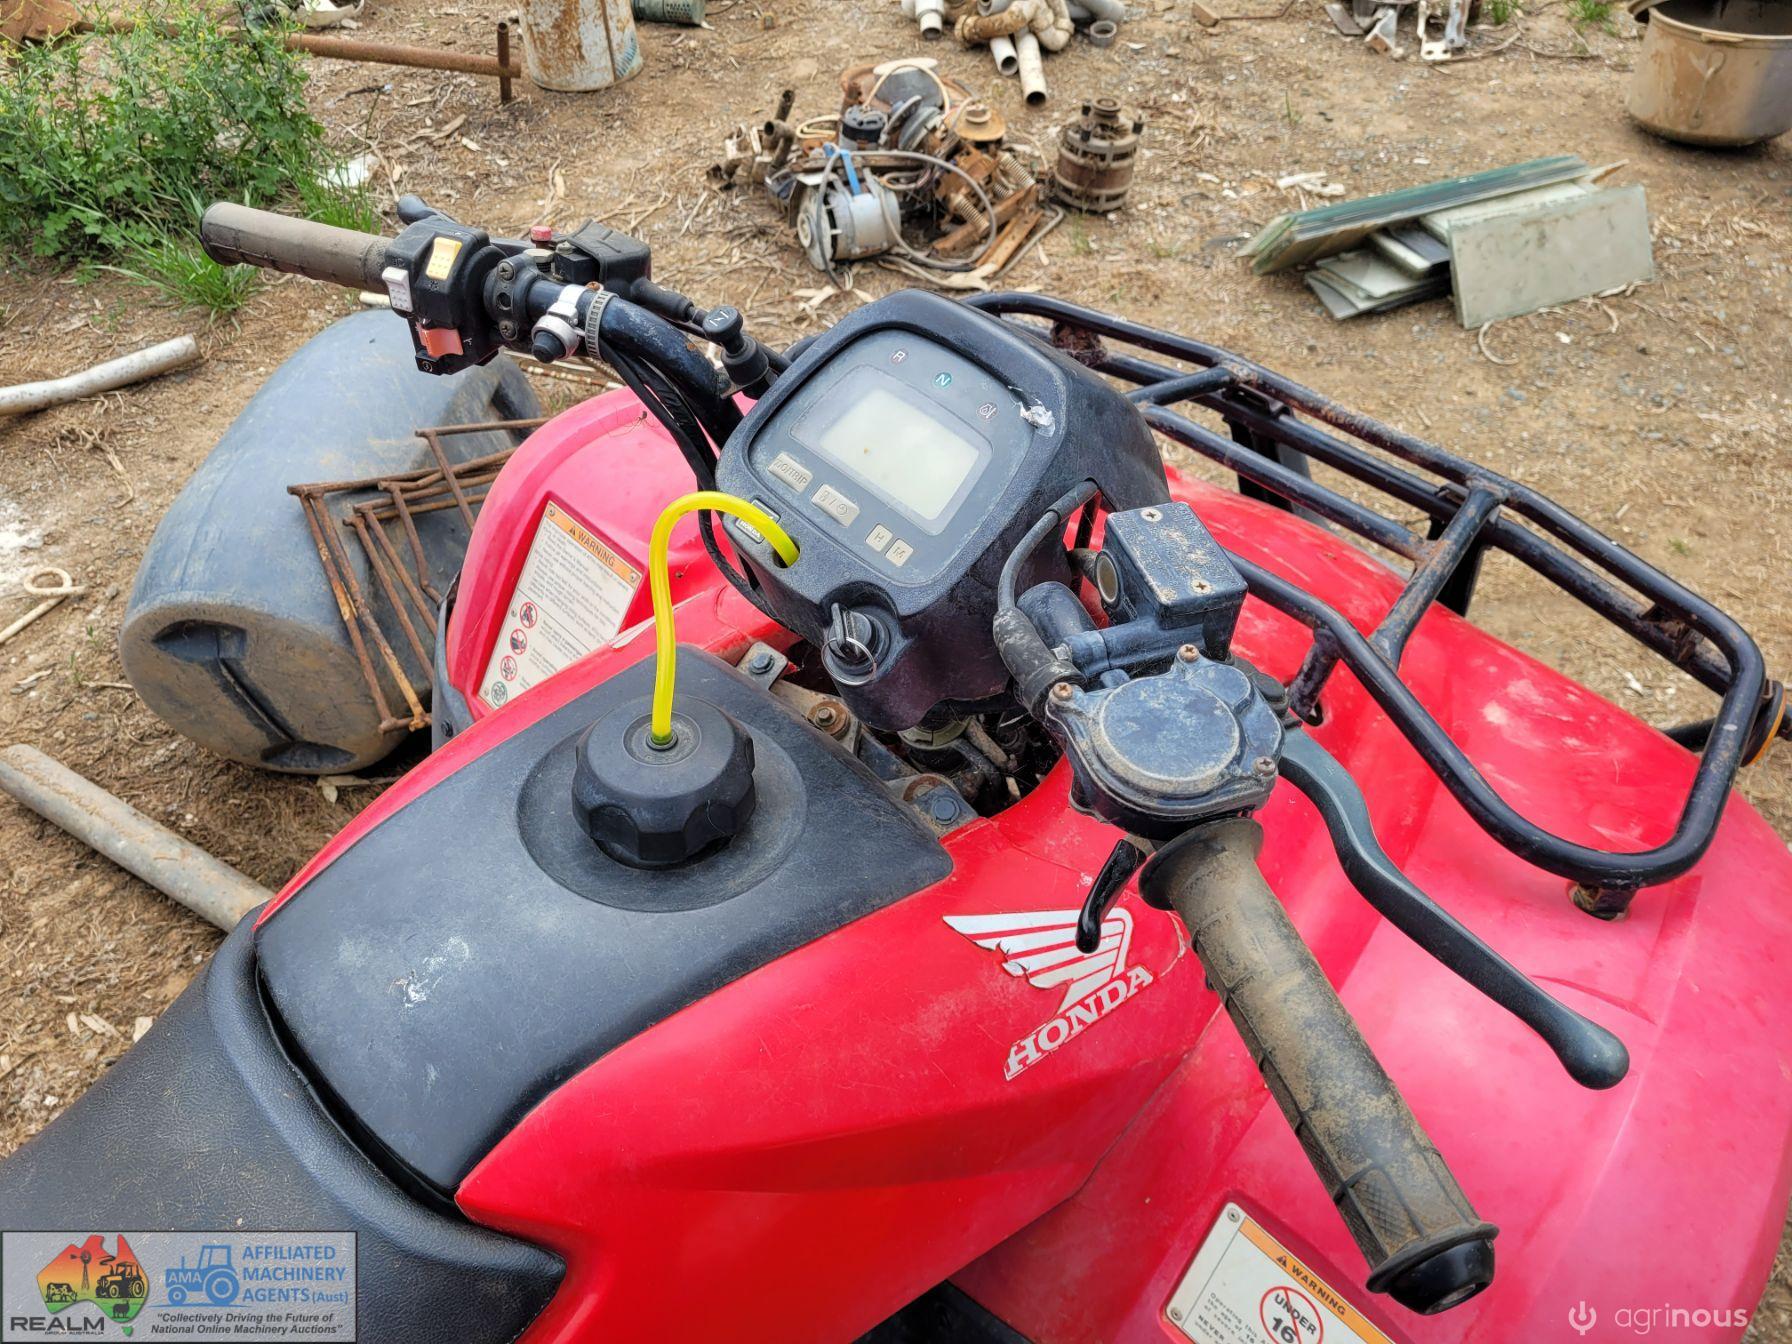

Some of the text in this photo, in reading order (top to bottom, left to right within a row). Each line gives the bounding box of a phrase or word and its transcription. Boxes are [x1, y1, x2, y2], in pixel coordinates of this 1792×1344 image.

[892, 350, 906, 362] R
[935, 373, 951, 386] N
[576, 529, 616, 567] WARNING
[1006, 966, 1153, 1077] HONDA
[1291, 1265, 1346, 1316] WARNING
[1198, 1314, 1225, 1342] NEVER
[1272, 1316, 1297, 1344] 16
[1274, 1293, 1317, 1336] UNDER
